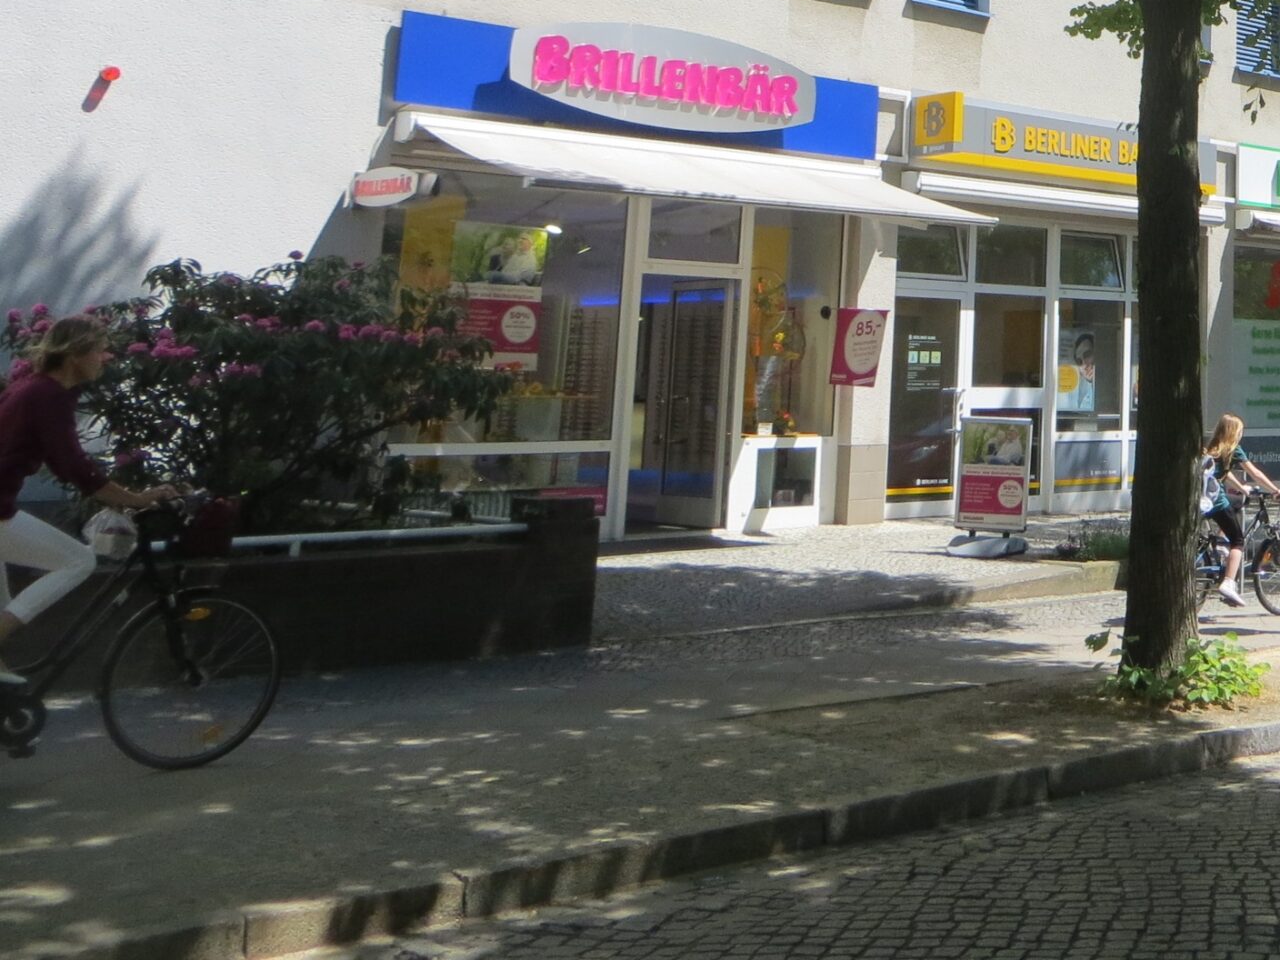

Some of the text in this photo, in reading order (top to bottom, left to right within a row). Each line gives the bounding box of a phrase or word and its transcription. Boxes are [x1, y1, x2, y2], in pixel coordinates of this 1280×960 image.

[532, 35, 799, 117] BRILLENBÄR
[1024, 126, 1112, 162] BERLINER
[1118, 140, 1139, 165] BA
